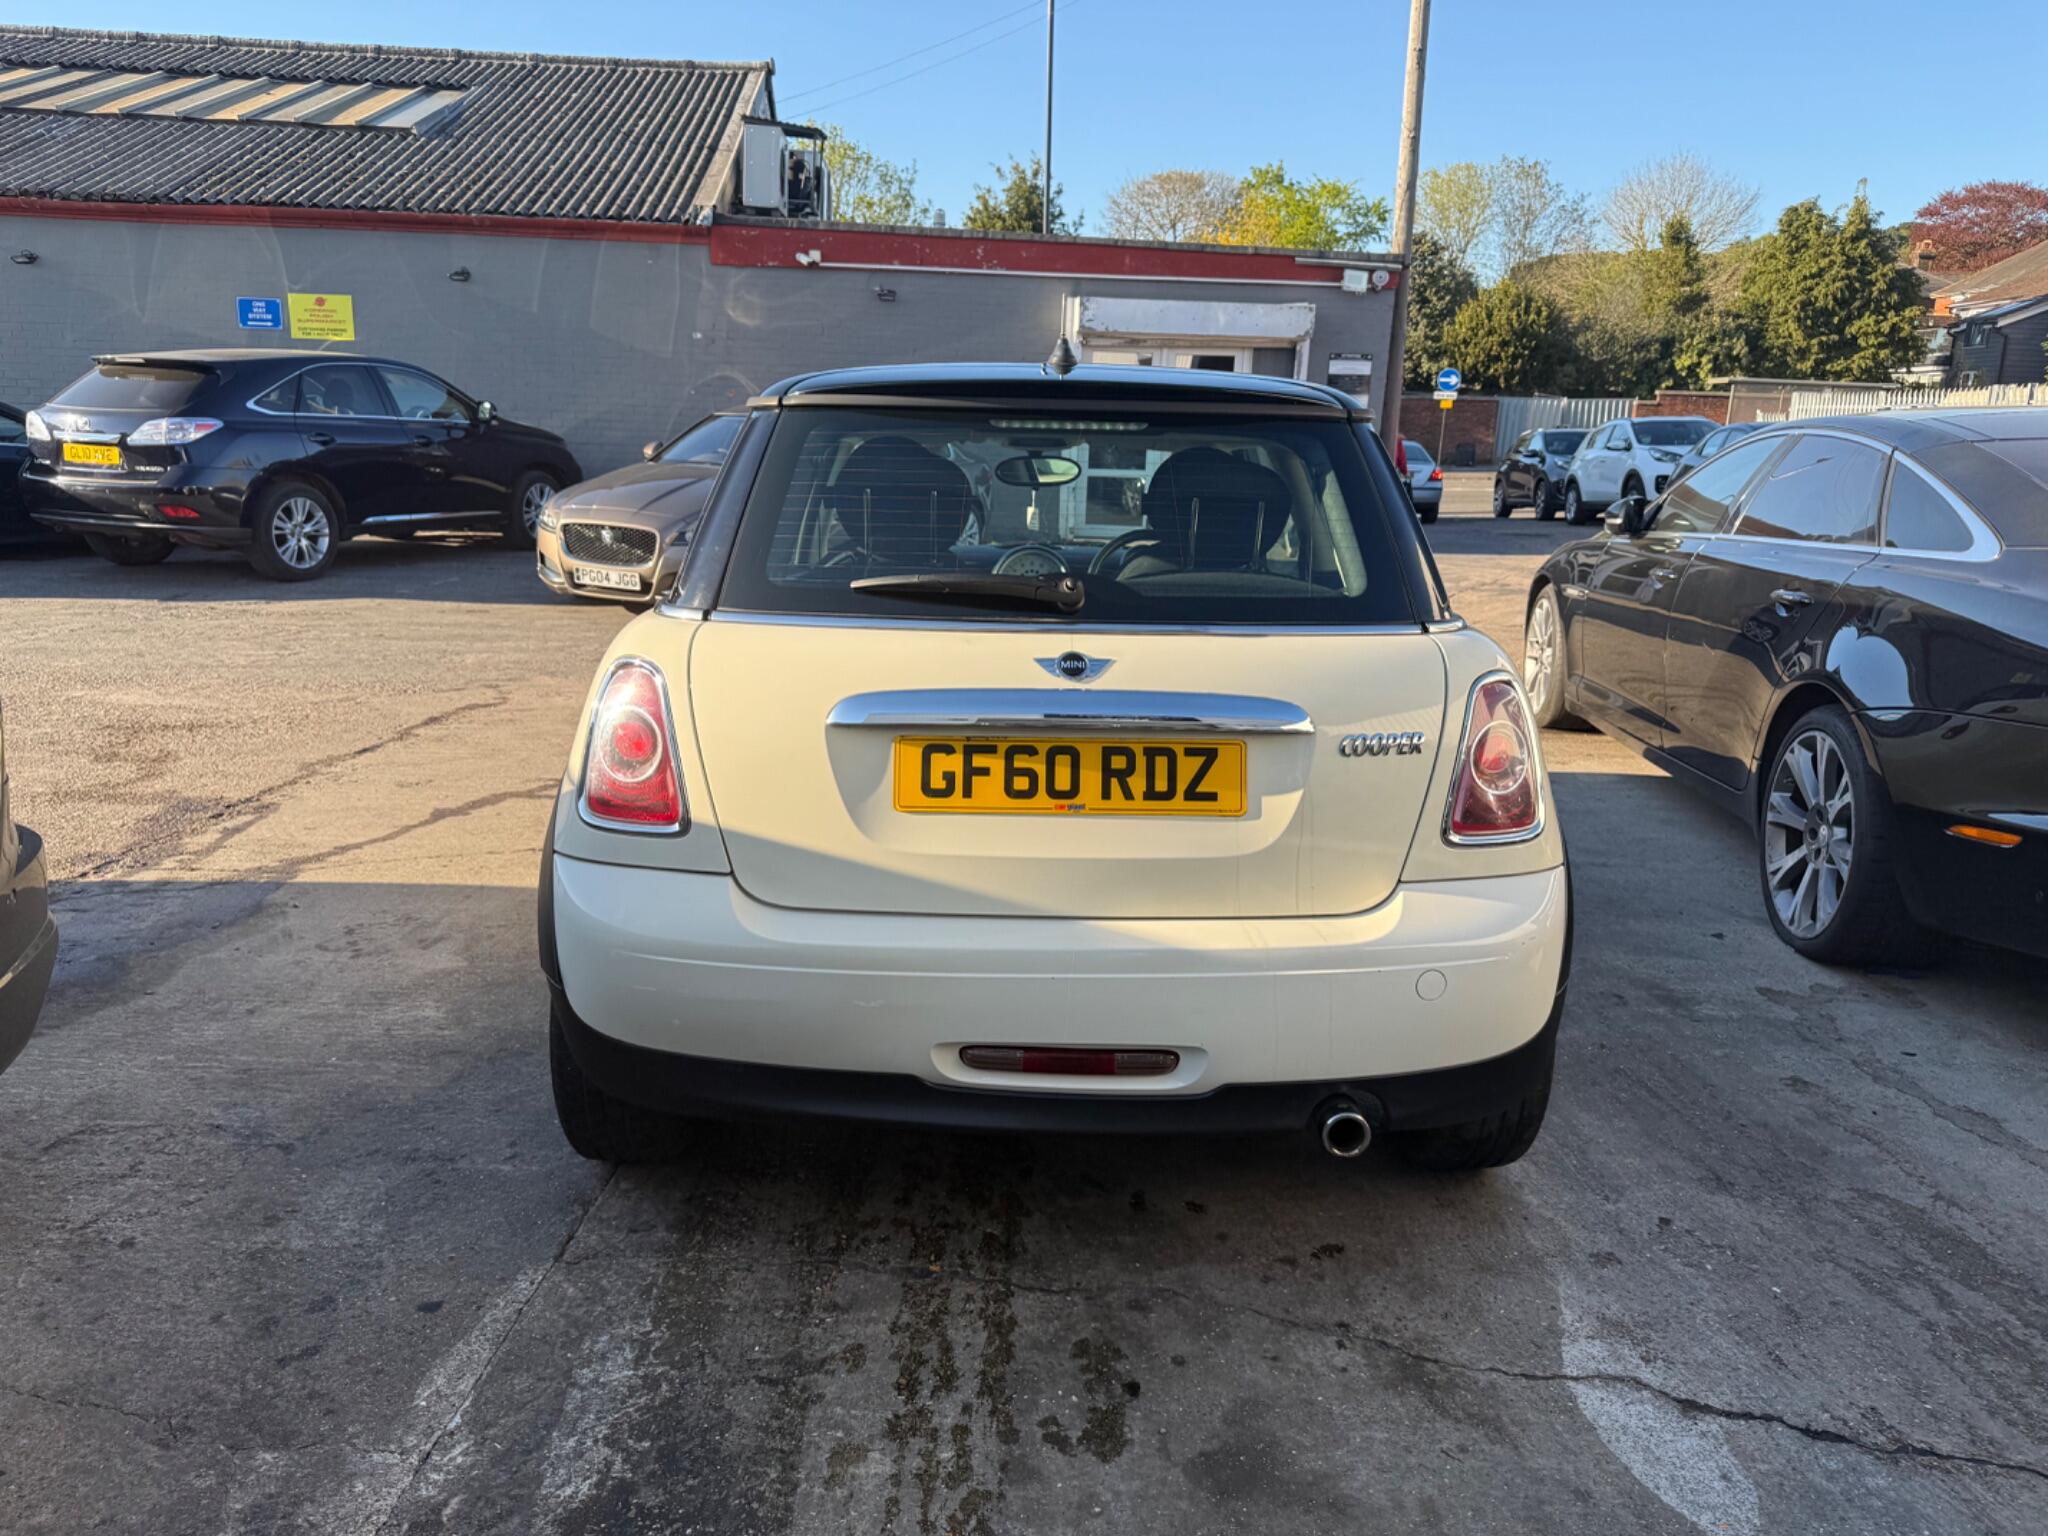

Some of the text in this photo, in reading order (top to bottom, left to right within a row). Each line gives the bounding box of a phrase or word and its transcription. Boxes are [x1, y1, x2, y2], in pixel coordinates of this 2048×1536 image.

[581, 568, 610, 584] PG04
[1060, 660, 1086, 669] MINI
[1339, 731, 1425, 757] COOPER
[920, 743, 1219, 802] GF60 RDZ
